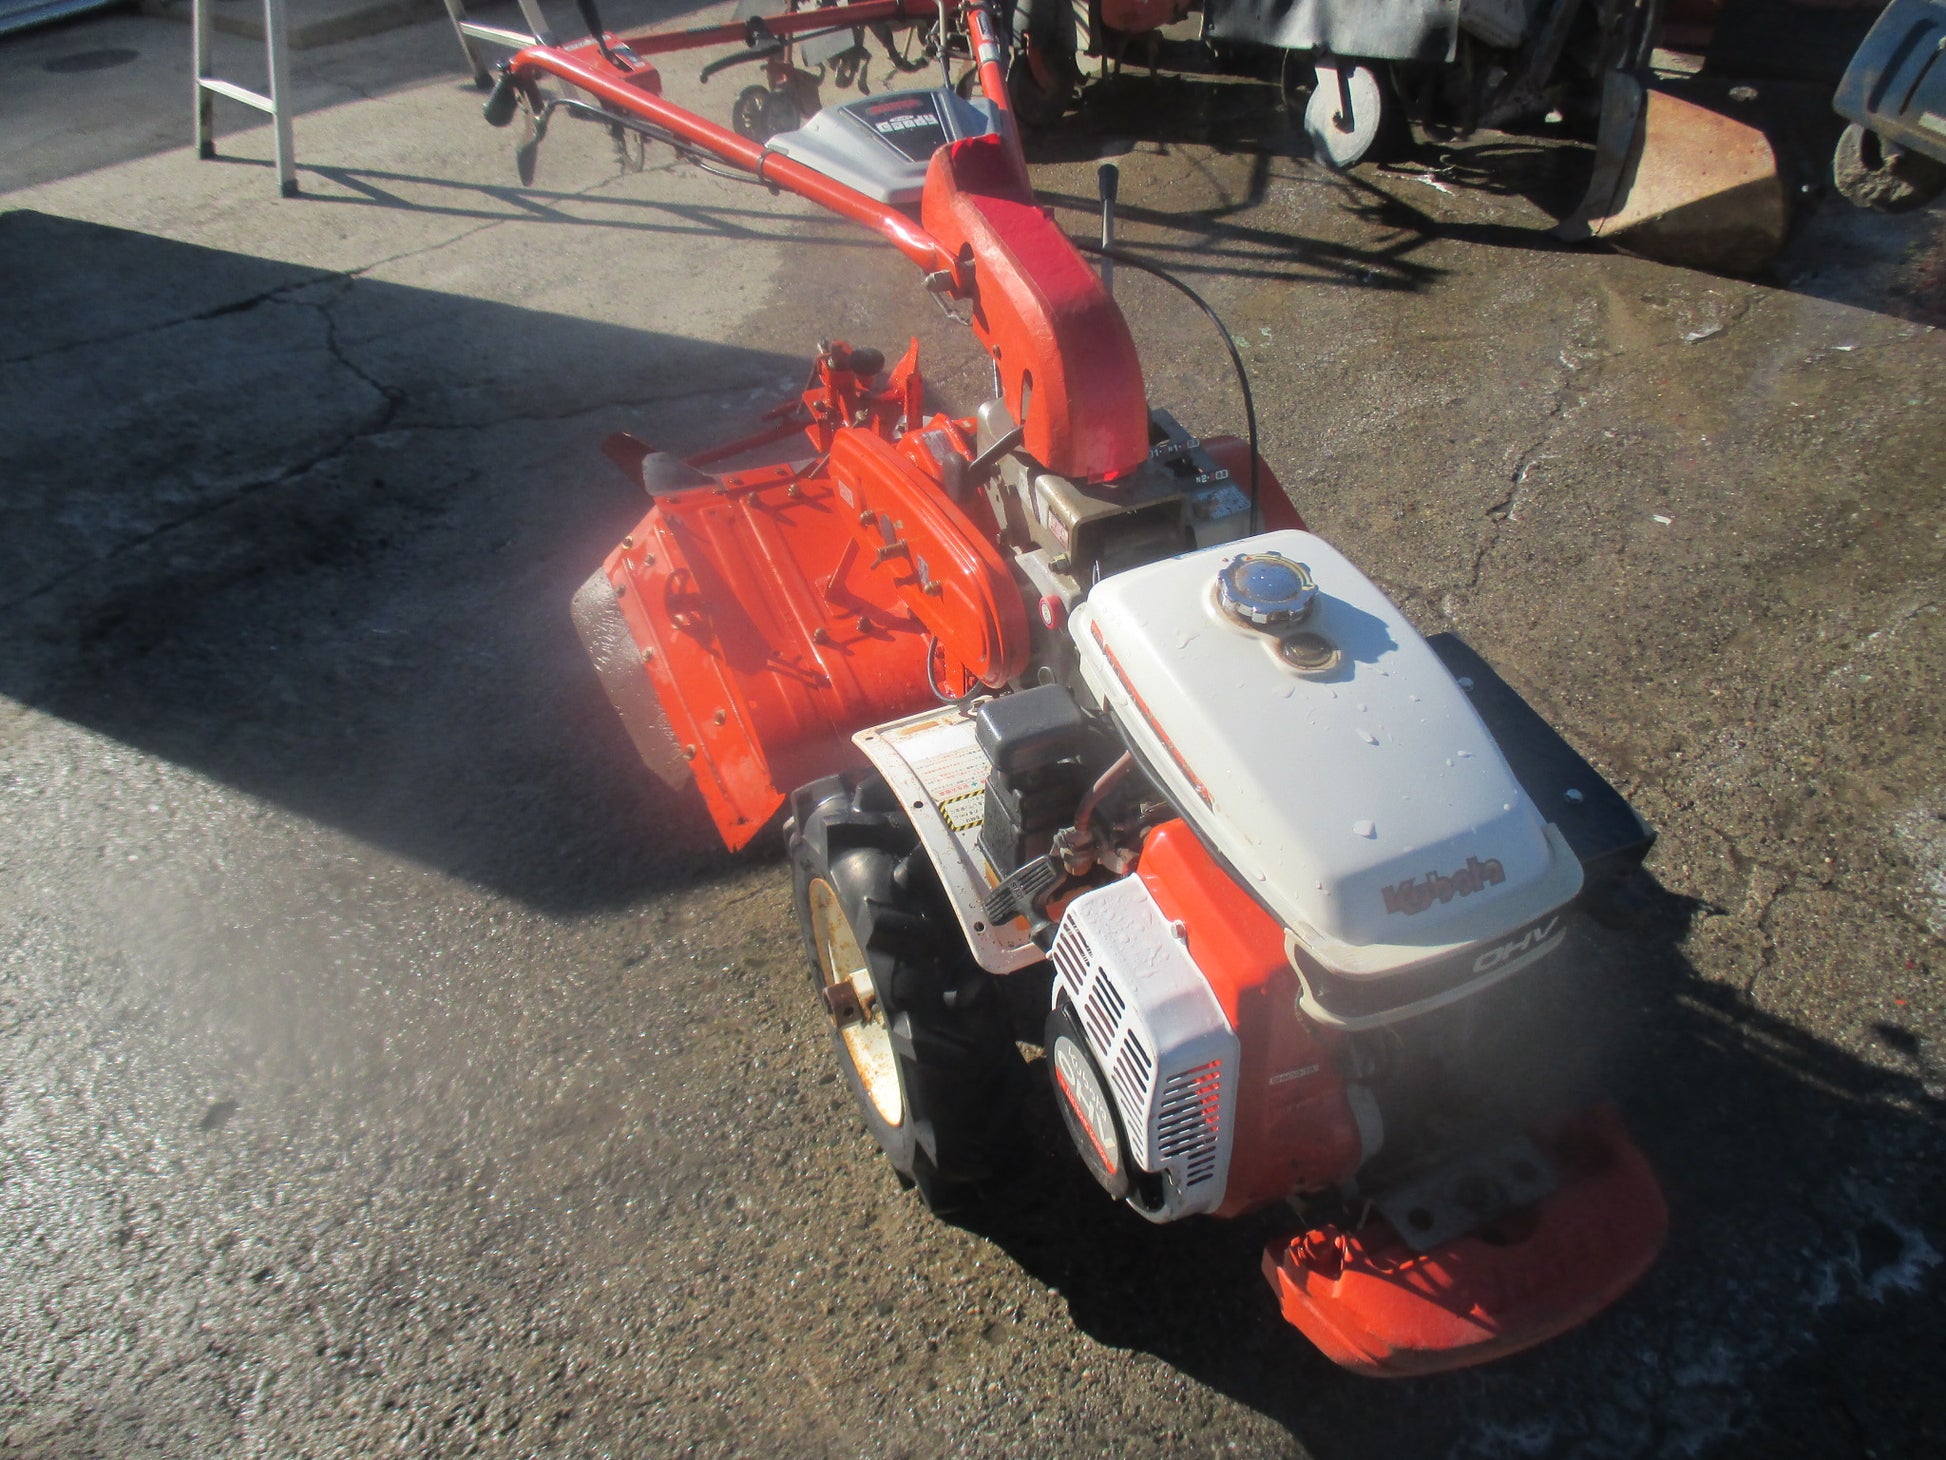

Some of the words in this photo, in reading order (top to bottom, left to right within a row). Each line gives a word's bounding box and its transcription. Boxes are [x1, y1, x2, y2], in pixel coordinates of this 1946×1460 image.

[1381, 856, 1506, 916] Kubota
[1473, 915, 1560, 973] OHV
[1057, 1049, 1116, 1149] OHV
[1068, 1045, 1107, 1122] Kubota
